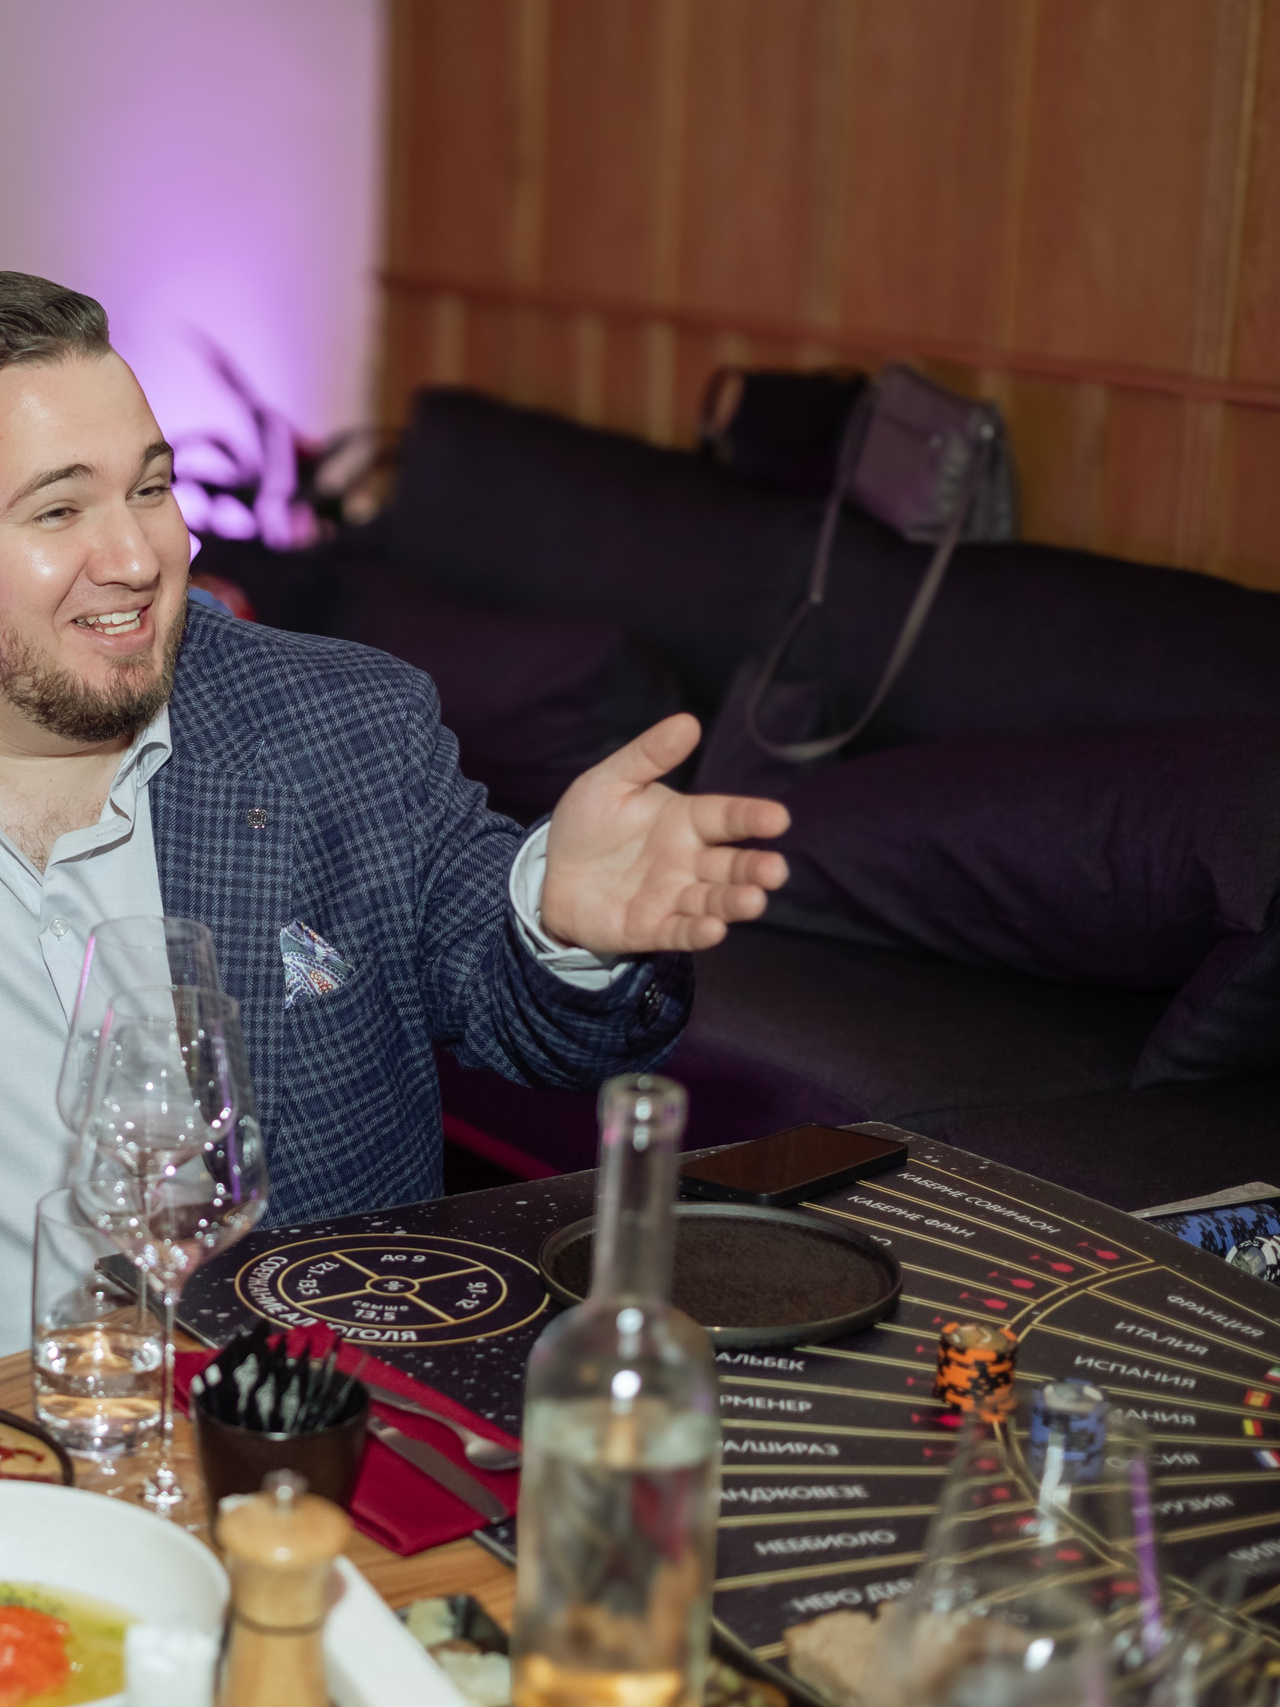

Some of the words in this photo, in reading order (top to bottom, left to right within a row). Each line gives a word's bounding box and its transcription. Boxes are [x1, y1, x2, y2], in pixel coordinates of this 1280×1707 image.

[847, 1195, 925, 1222] КАБЕРНЕ
[923, 1218, 976, 1238] ФРАН
[896, 1171, 967, 1200] КАБЕРНЕ
[964, 1195, 1062, 1236] СОВИНЬОН
[380, 1254, 407, 1263] до
[351, 1300, 409, 1312] свыше
[354, 1308, 396, 1322] 13,5
[1166, 1295, 1265, 1337] ФРАНЦИЯ
[278, 1312, 418, 1342] АЛОГОЛЯ
[1114, 1321, 1209, 1356] ИТАЛИЯ
[714, 1351, 806, 1372] АЛЬБЕК
[1074, 1355, 1197, 1390] ИСПАНИЯ
[719, 1394, 813, 1413] РМЕНЕР
[719, 1484, 870, 1503] НДЖОВЕЗЕ
[1156, 1495, 1235, 1514] РУЗИЯ
[754, 1528, 898, 1557] НЕББИОЛО
[791, 1587, 863, 1613] НЕРО
